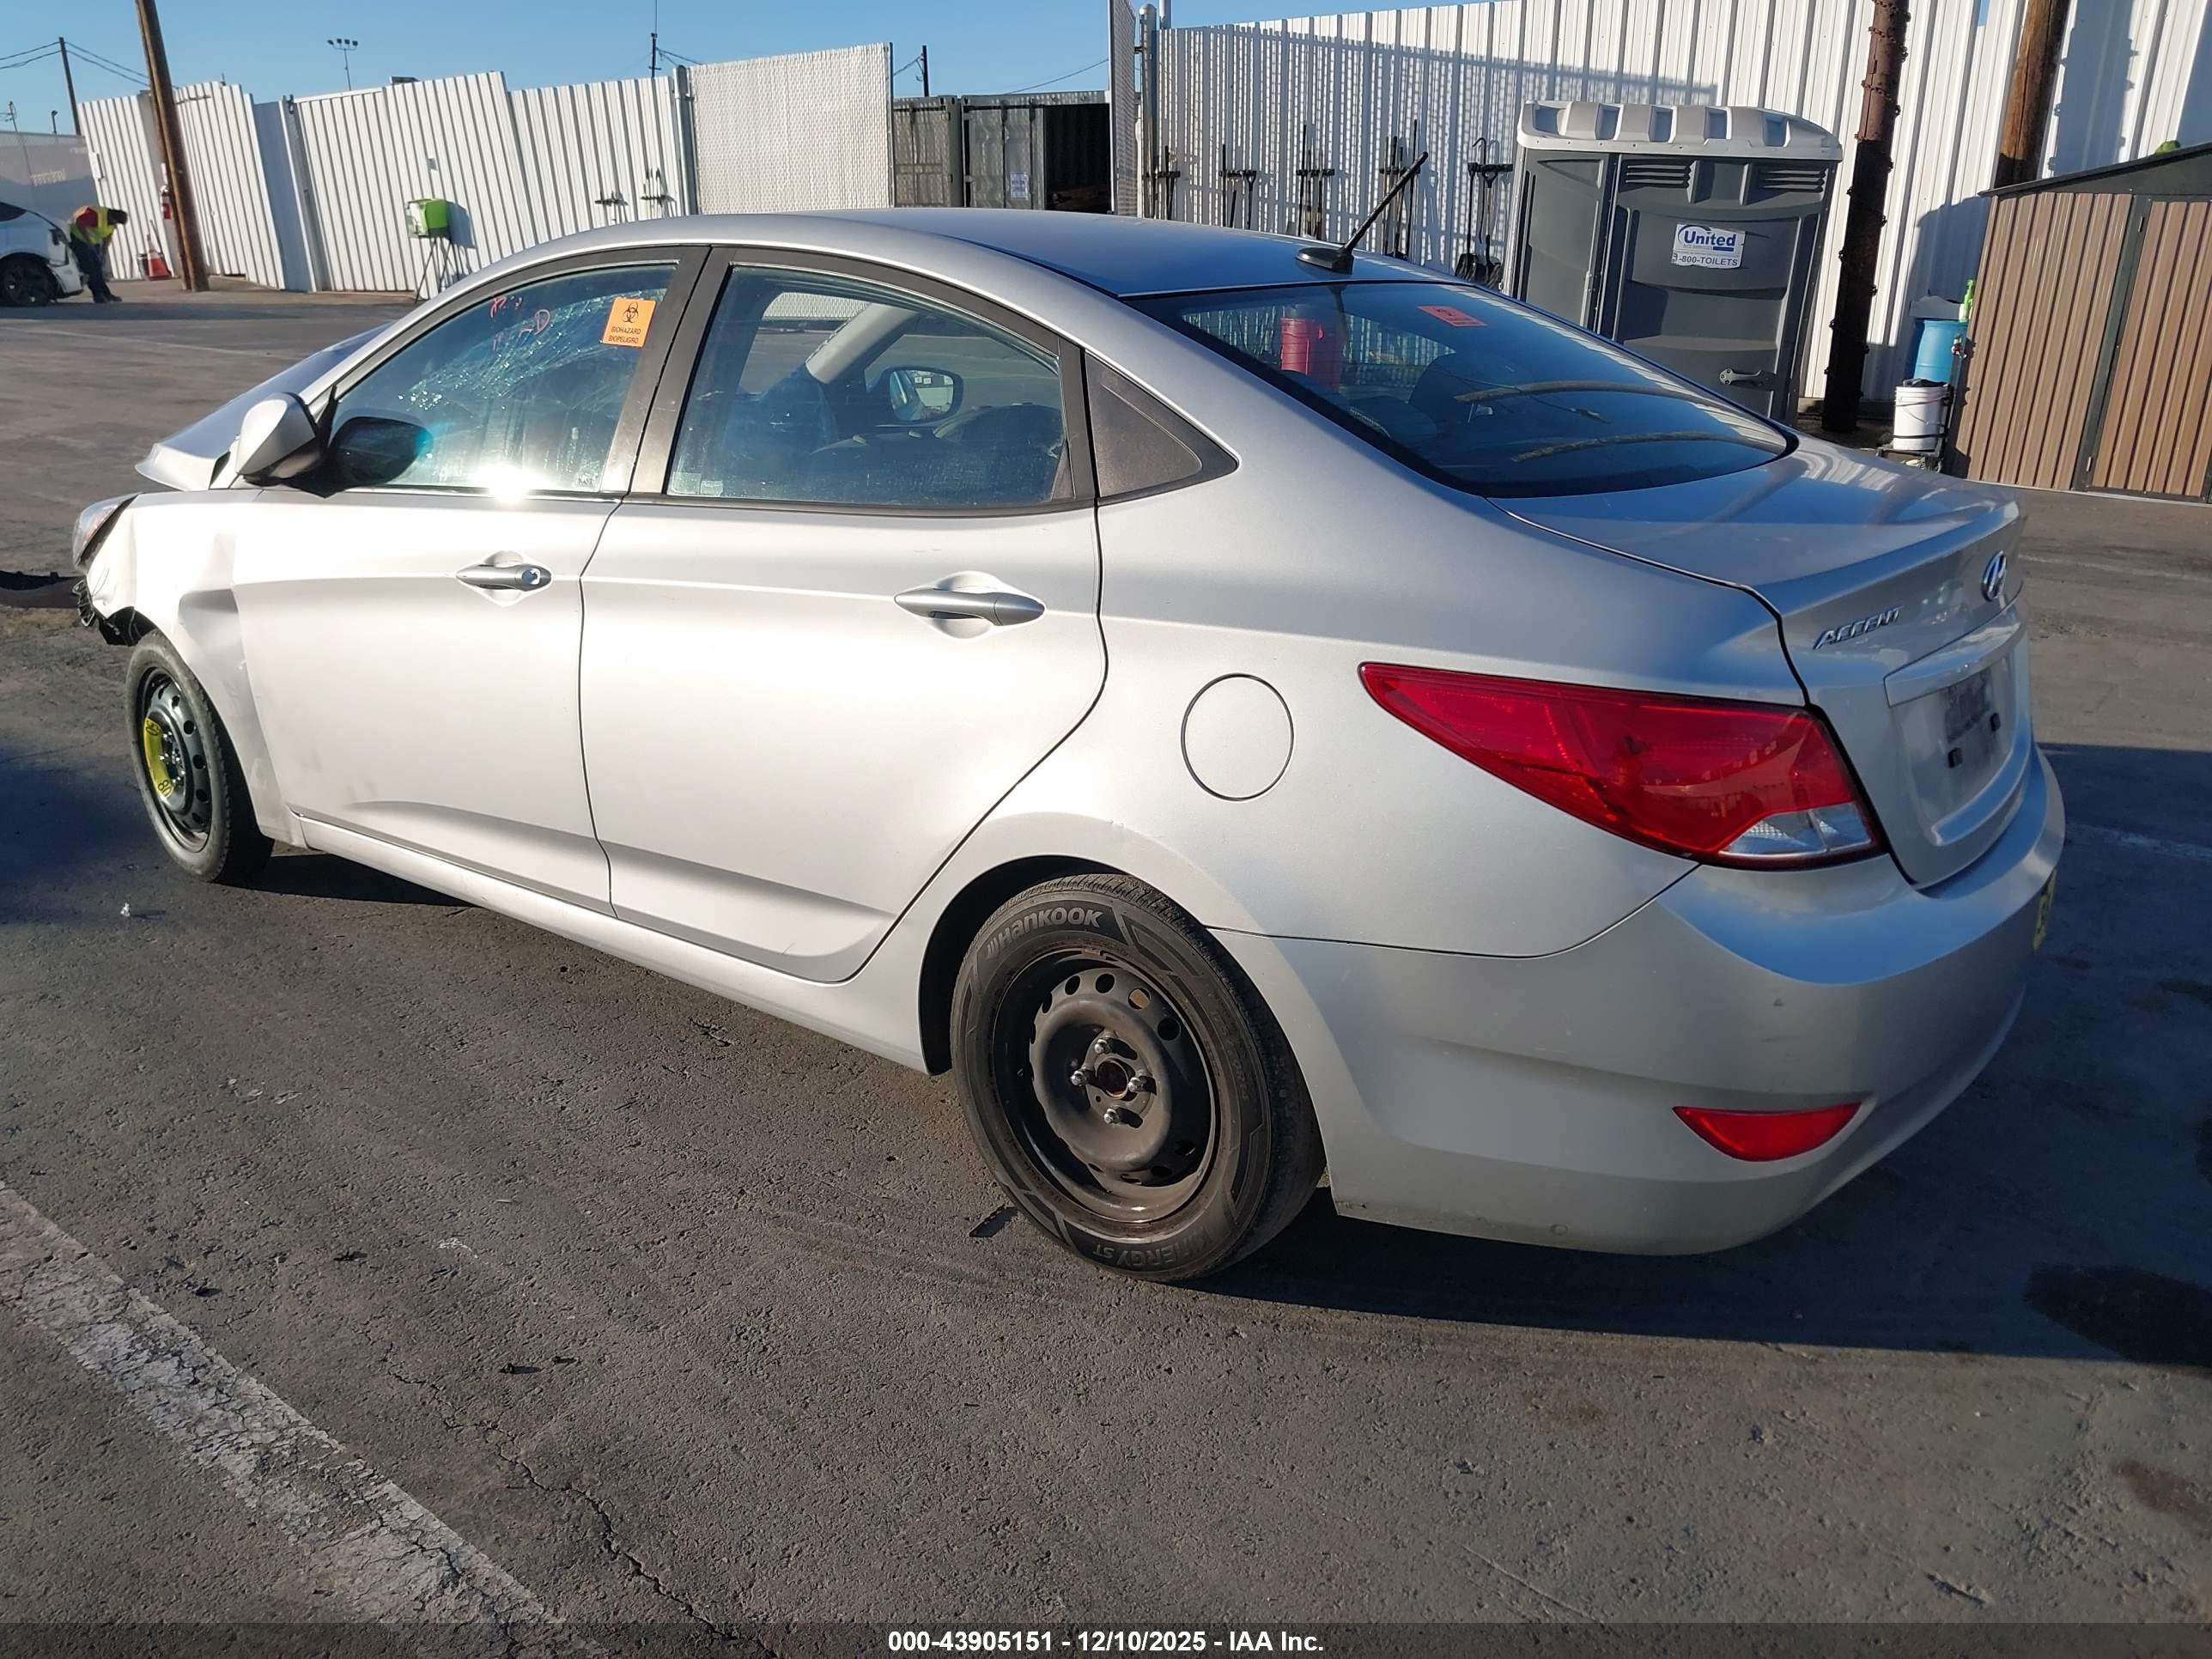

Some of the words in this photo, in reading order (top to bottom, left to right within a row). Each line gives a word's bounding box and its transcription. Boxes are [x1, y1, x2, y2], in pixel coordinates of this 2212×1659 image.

[1684, 230, 1736, 246] United
[611, 326, 641, 335] BIOHAZARD
[608, 335, 640, 344] BIOPELIGRO
[1813, 606, 1903, 649] ACCENT
